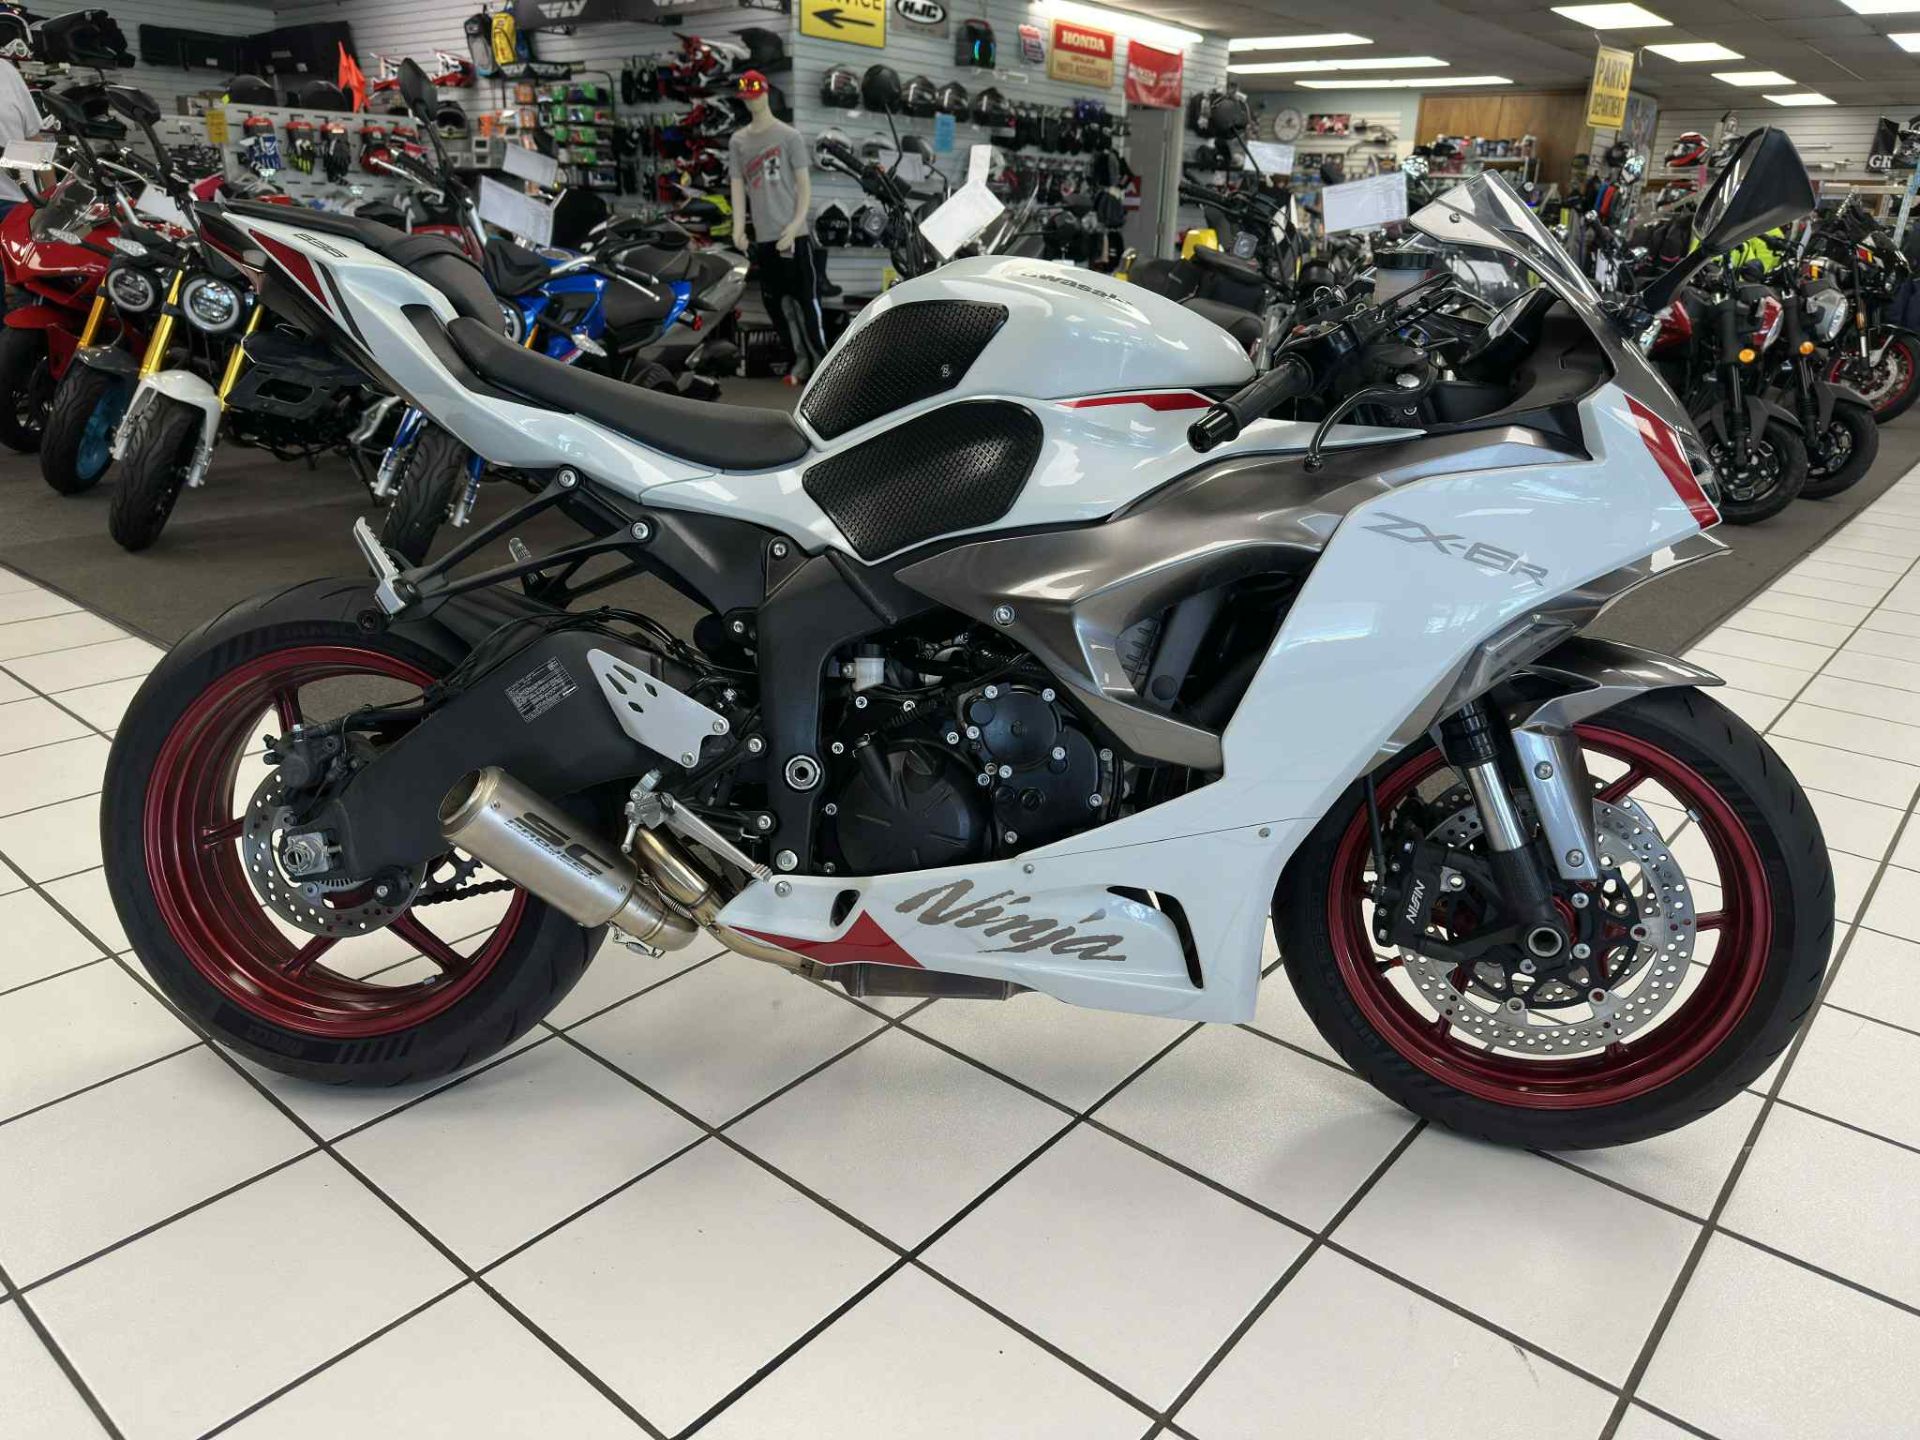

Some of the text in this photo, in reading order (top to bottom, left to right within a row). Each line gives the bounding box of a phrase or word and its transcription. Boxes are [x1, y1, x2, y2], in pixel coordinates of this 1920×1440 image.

[537, 0, 588, 19] FLY
[902, 1, 939, 19] HJC
[1062, 30, 1107, 52] HONDA
[1596, 56, 1630, 91] PARTS
[1591, 92, 1625, 118] DEPARTMENT
[1360, 512, 1549, 587] ZX-6R
[513, 811, 615, 877] SC
[895, 879, 1127, 961] Ninja
